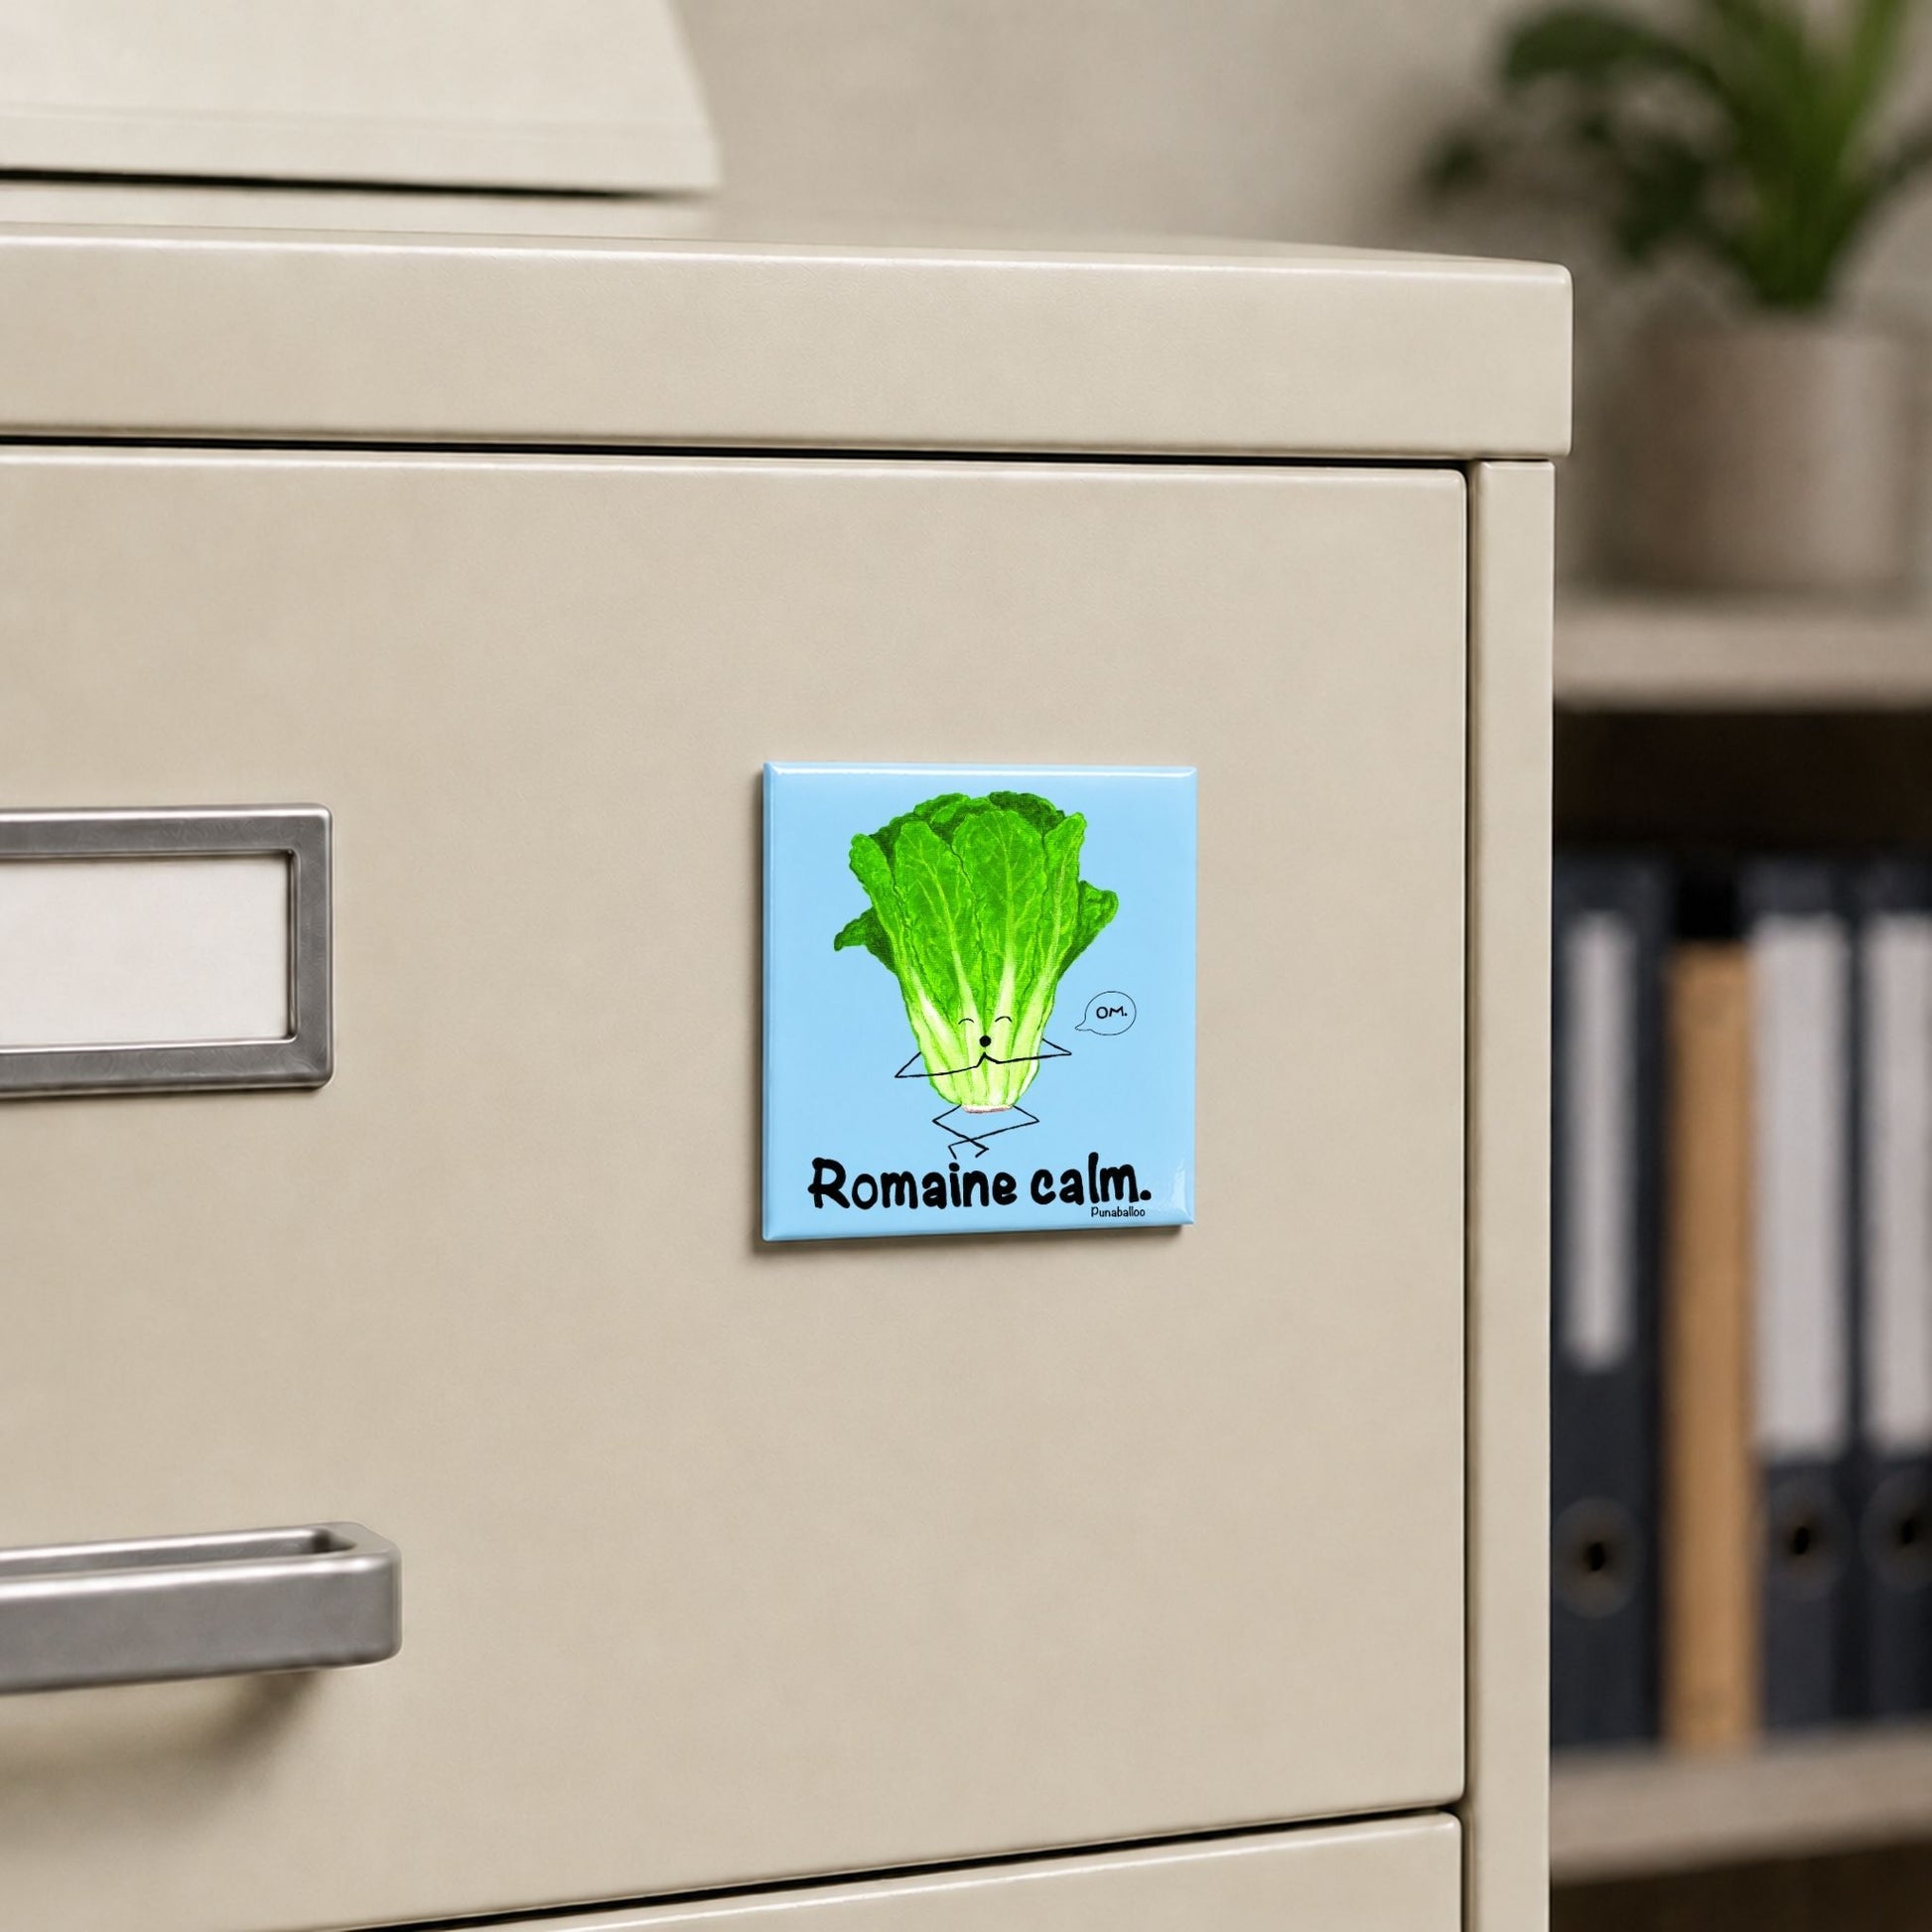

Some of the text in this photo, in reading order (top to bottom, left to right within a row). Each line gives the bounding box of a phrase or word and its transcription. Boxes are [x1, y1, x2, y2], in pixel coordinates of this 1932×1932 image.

[1096, 1006, 1128, 1020] OM.
[807, 1151, 1152, 1210] Romaine calm.
[1091, 1205, 1146, 1218] Punaballoo
